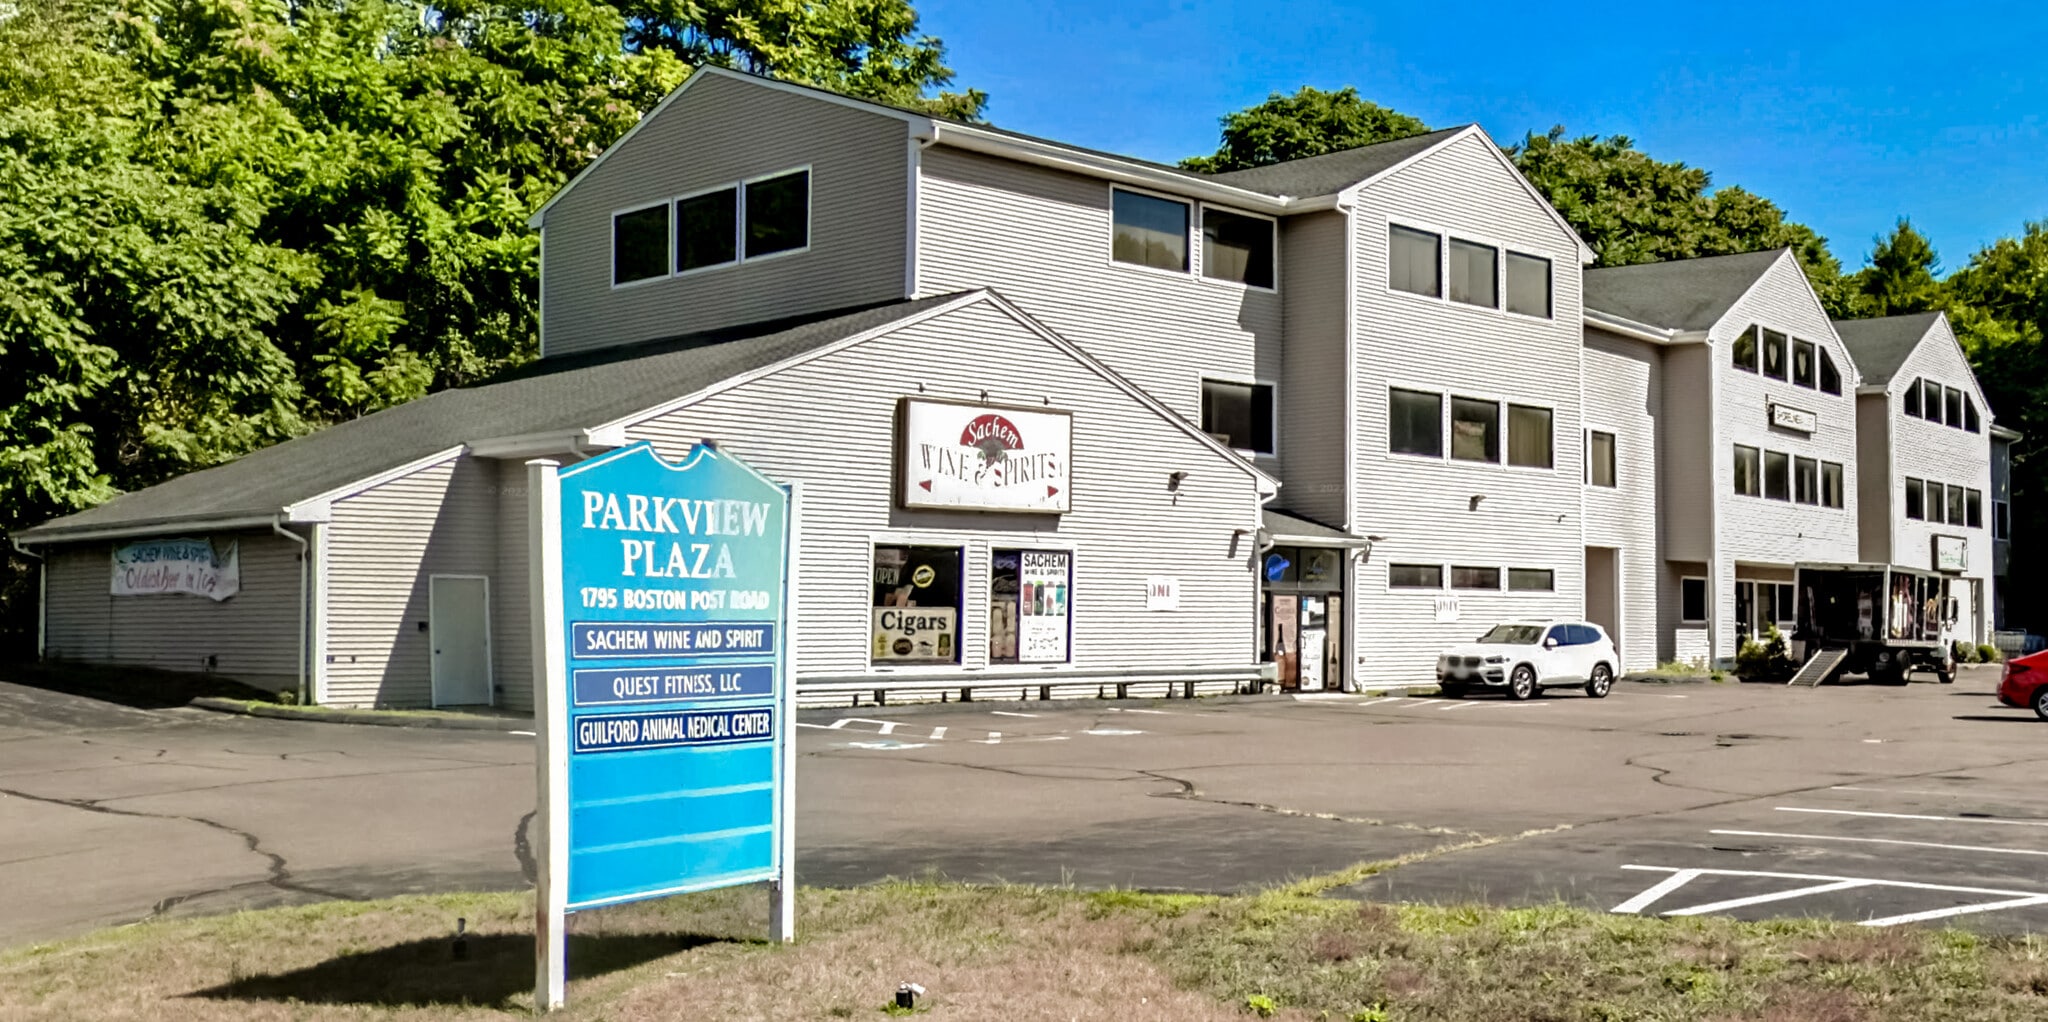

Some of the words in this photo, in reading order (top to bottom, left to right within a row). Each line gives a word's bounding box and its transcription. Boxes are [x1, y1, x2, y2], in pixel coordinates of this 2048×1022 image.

[967, 416, 1019, 449] Sachem
[920, 443, 970, 483] WINE
[994, 452, 1057, 488] SPIRITS
[581, 490, 771, 537] PARKVIEW
[621, 539, 737, 579] PLAZA
[1024, 554, 1066, 568] SACHEM
[875, 566, 900, 586] OPEN
[580, 587, 618, 609] 1795
[623, 588, 687, 611] BOSTON
[690, 589, 727, 610] POST
[729, 590, 771, 611] ROAD
[880, 610, 948, 637] Cigars
[586, 630, 648, 650] SACHEM
[653, 630, 692, 650] WINE
[694, 629, 723, 649] AND
[725, 629, 765, 648] SPIRIT
[612, 676, 660, 699] QUEST
[719, 672, 742, 692] LLC
[579, 720, 640, 746] GUILFORD
[641, 716, 686, 742] ANIMAL
[731, 711, 771, 734] CENTER
